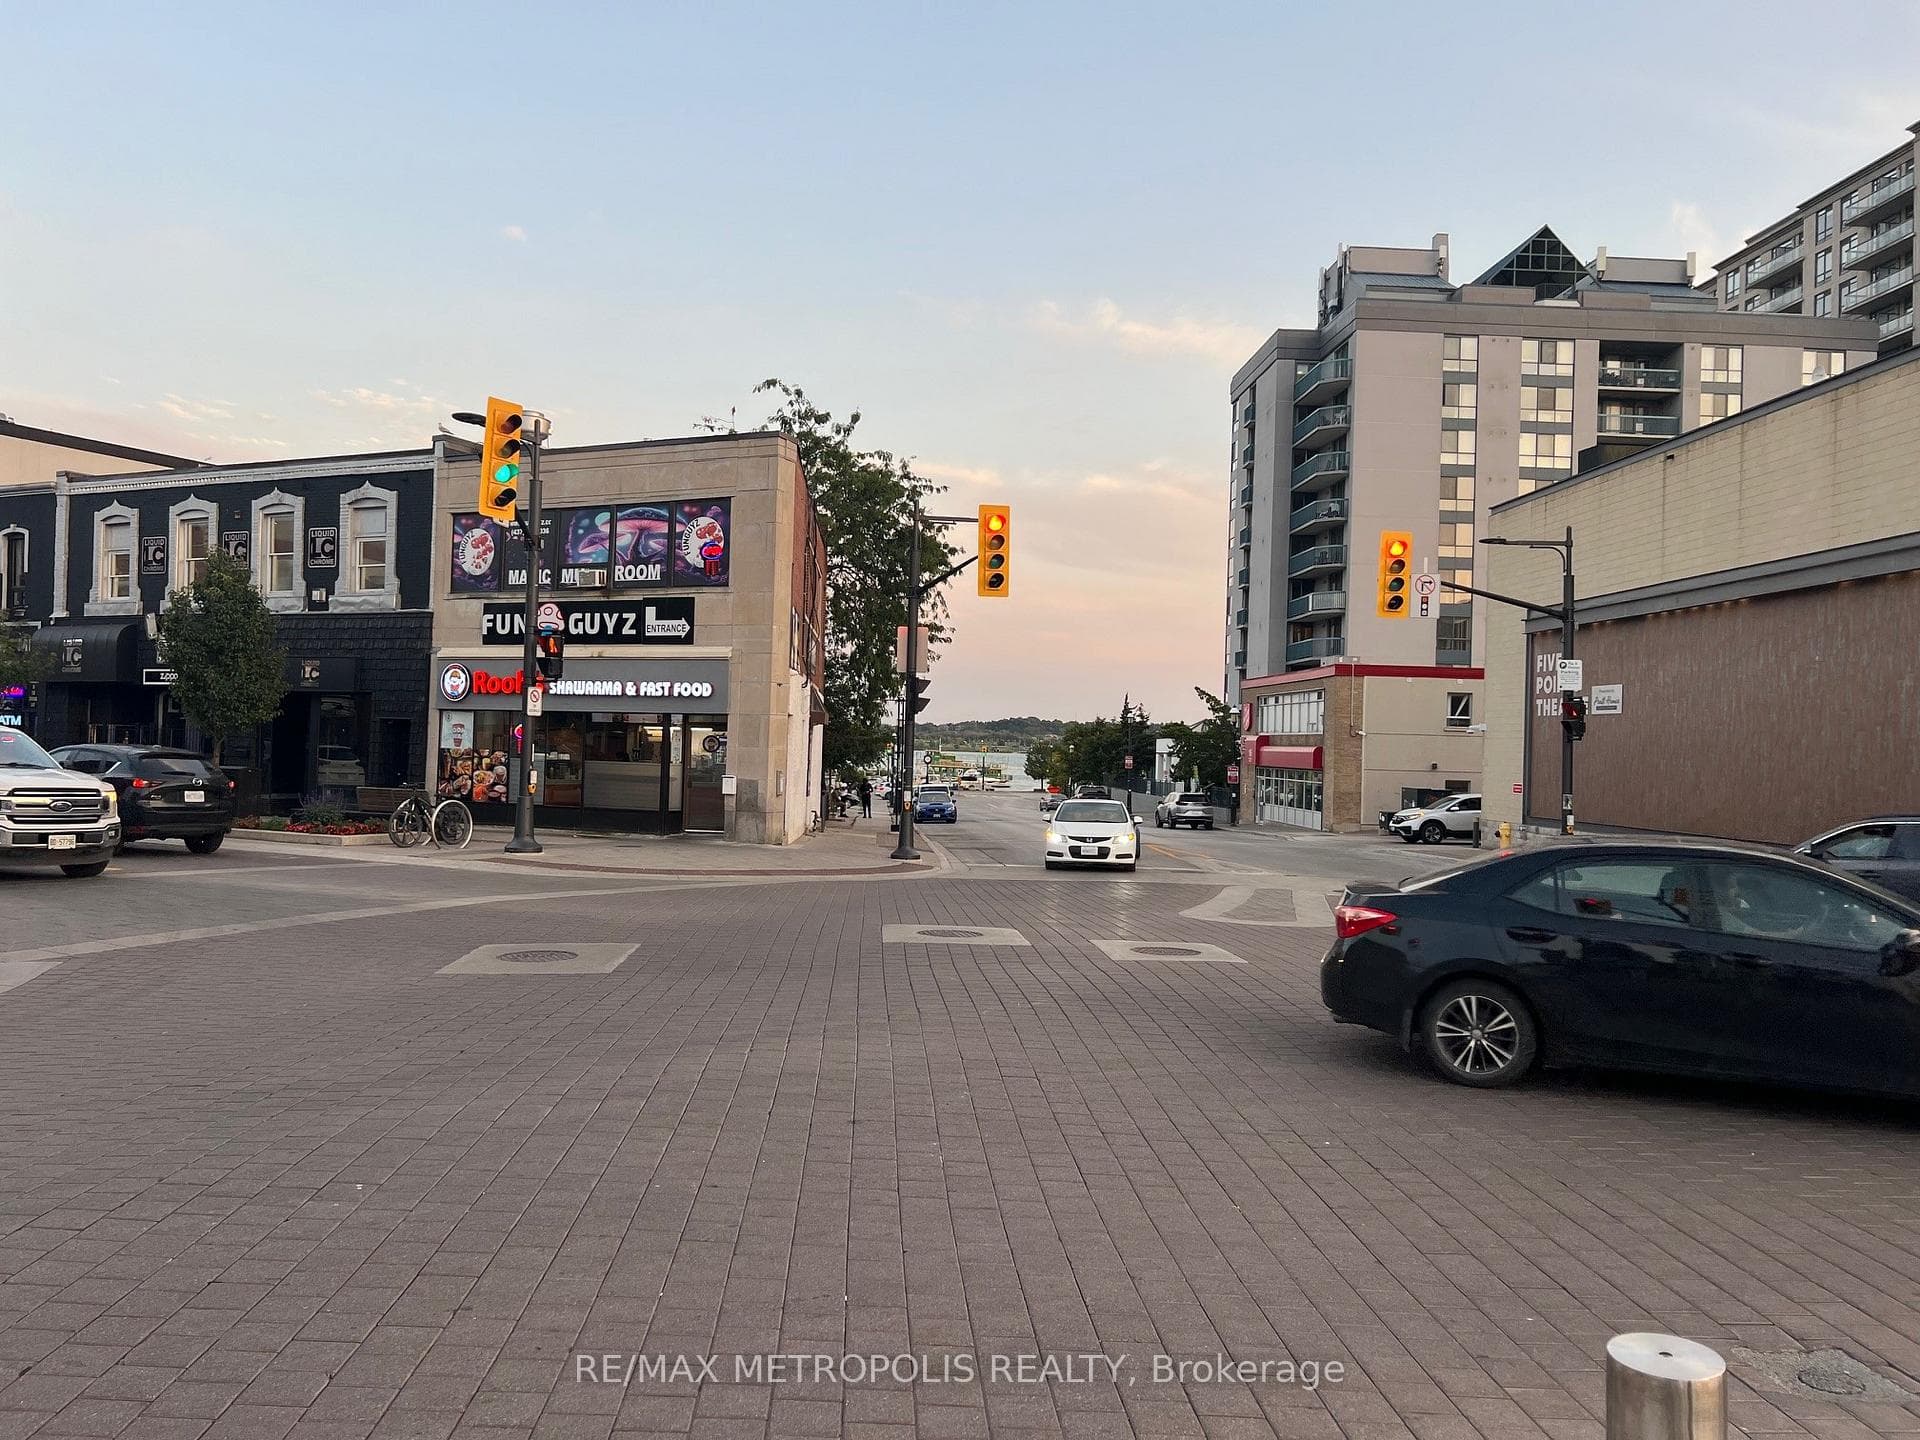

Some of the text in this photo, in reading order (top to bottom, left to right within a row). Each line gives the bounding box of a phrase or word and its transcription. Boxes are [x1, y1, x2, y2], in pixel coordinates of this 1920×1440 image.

[224, 532, 247, 541] LIQUID
[311, 530, 335, 538] LIQUID
[144, 538, 165, 547] LIQUID
[508, 568, 552, 585] MAIC
[614, 563, 662, 582] ROOM
[482, 612, 637, 635] FUN GUYZ
[646, 622, 687, 633] ENTRANCE
[549, 680, 623, 697] SHAWARMA
[625, 681, 637, 697] &
[639, 681, 672, 697] FAST
[673, 682, 713, 697] FOOD
[0, 715, 22, 726] ATM
